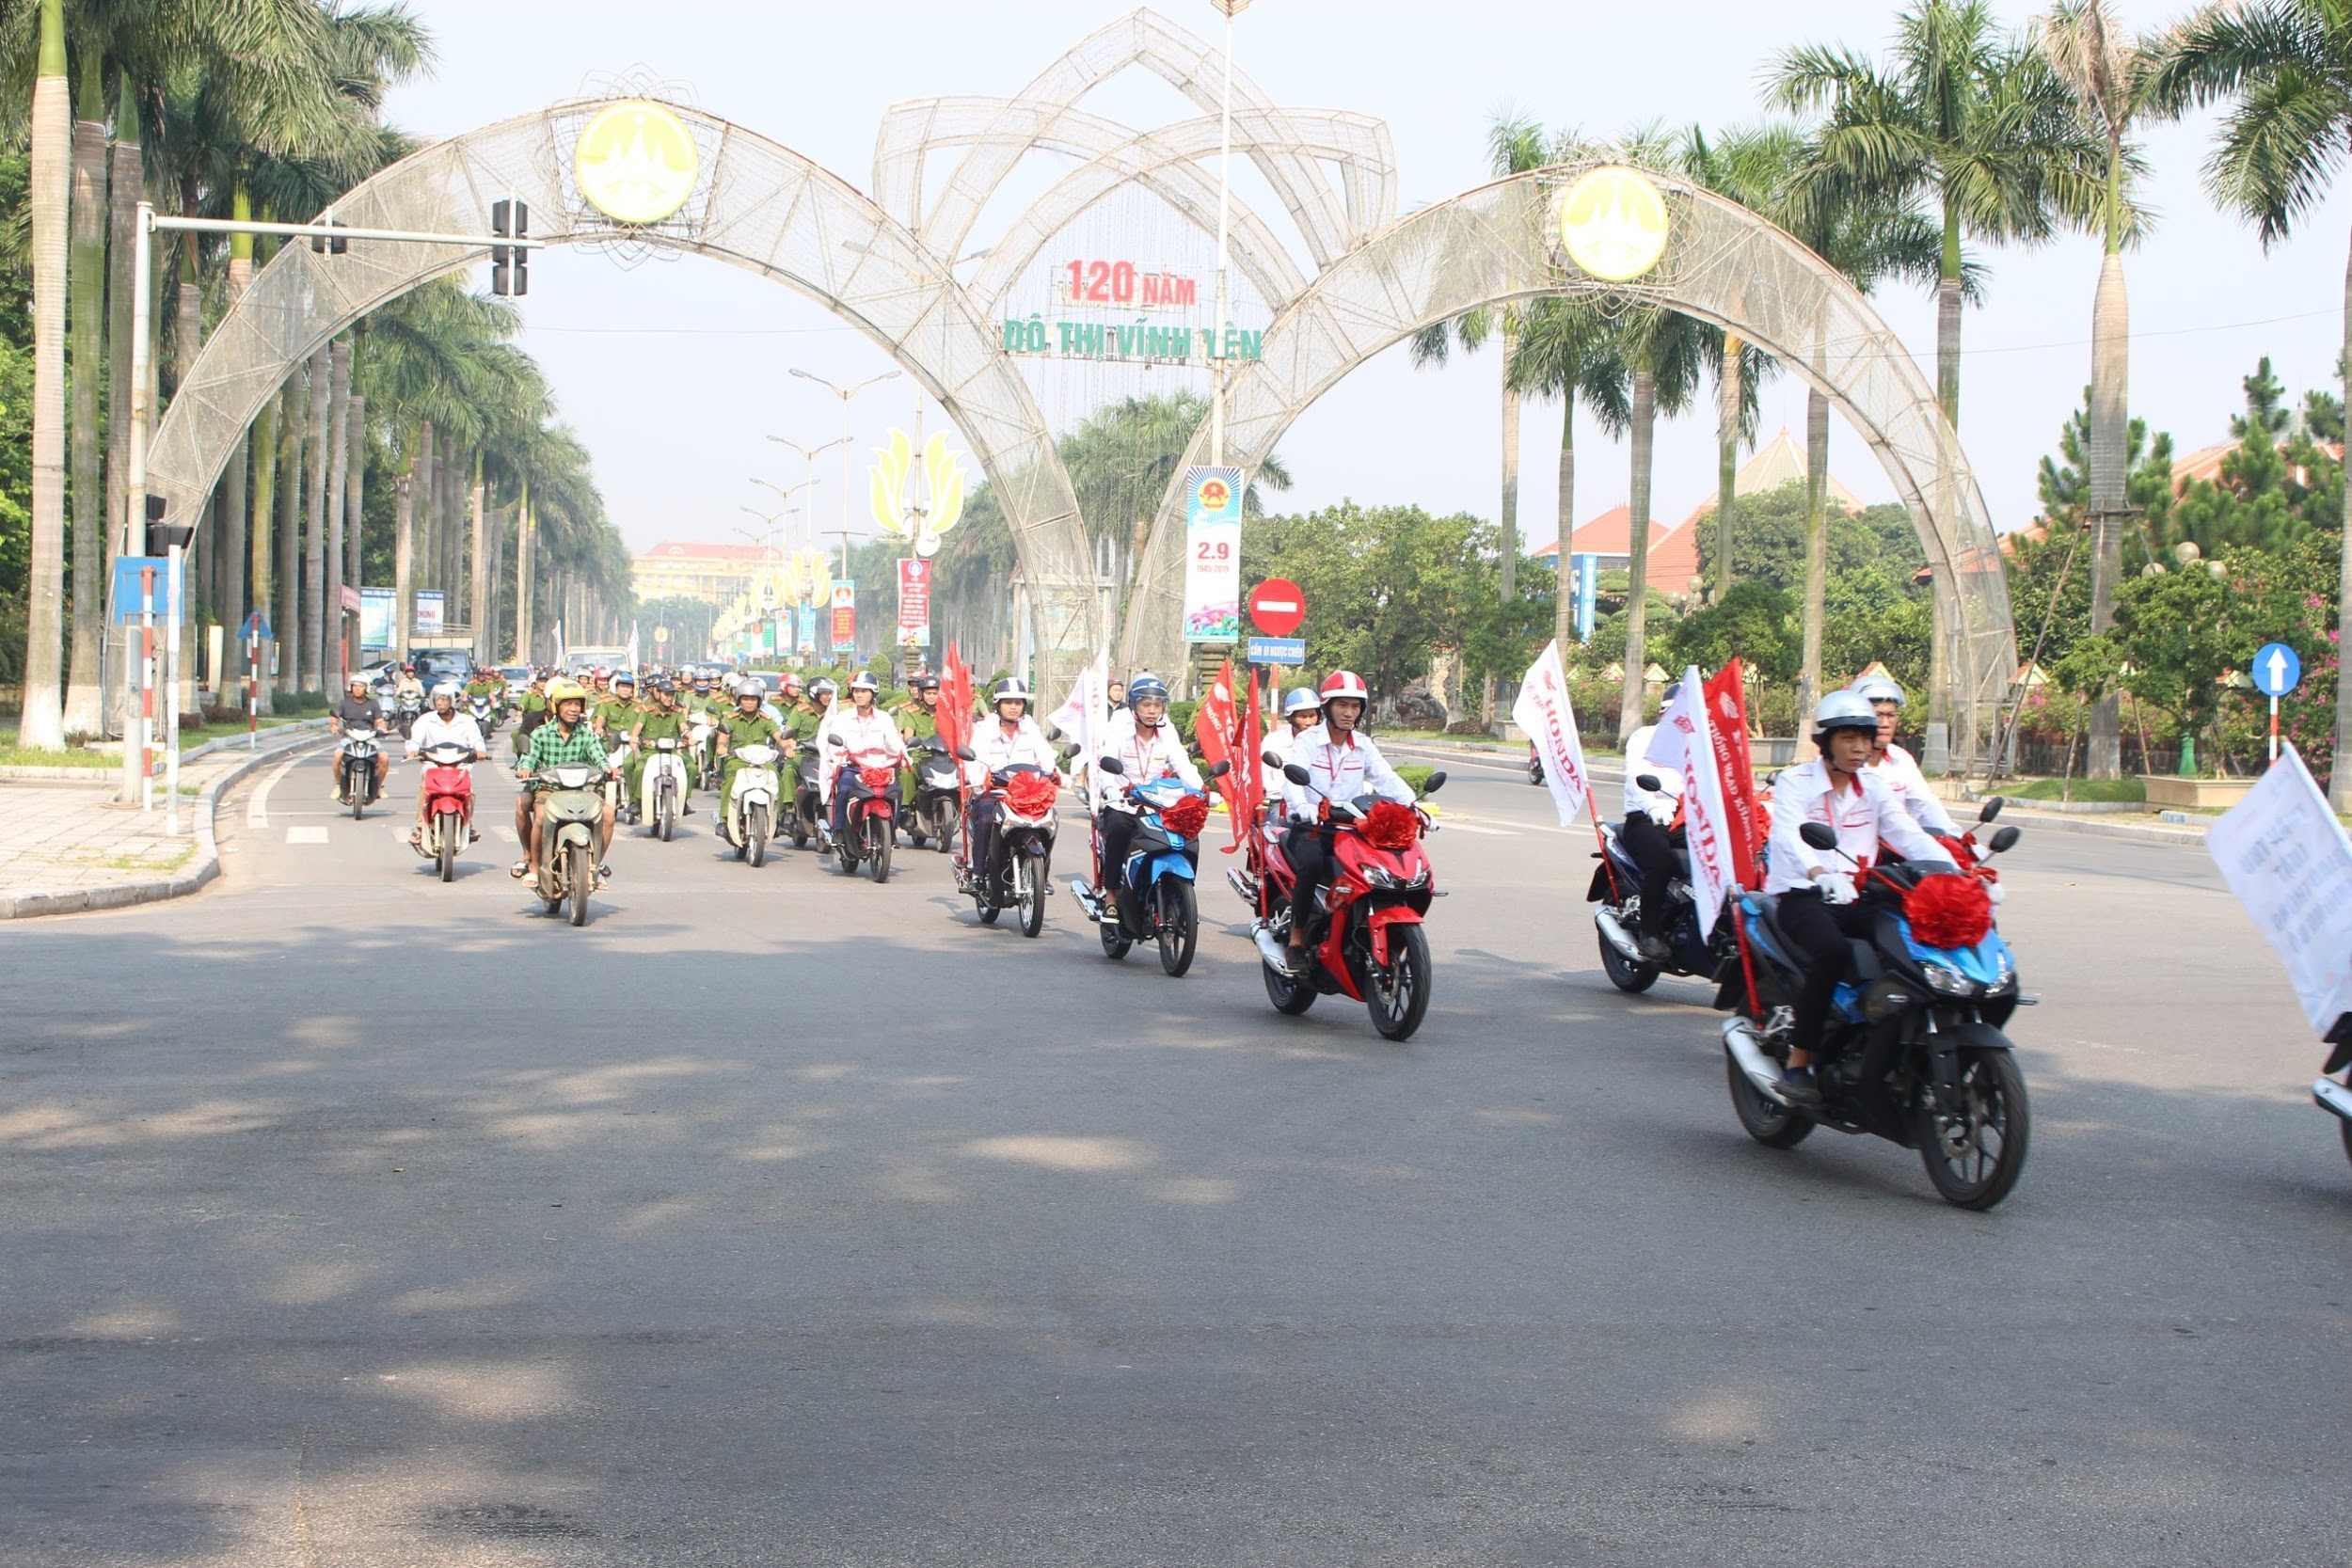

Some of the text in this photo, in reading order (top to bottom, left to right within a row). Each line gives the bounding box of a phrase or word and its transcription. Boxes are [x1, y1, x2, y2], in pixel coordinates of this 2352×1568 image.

[1067, 260, 1196, 306] 120 NĂM
[1057, 322, 1104, 362] THỊ
[1117, 316, 1191, 357] VĨNH
[1198, 542, 1230, 560] 2.9
[1542, 699, 1582, 794] HONDA
